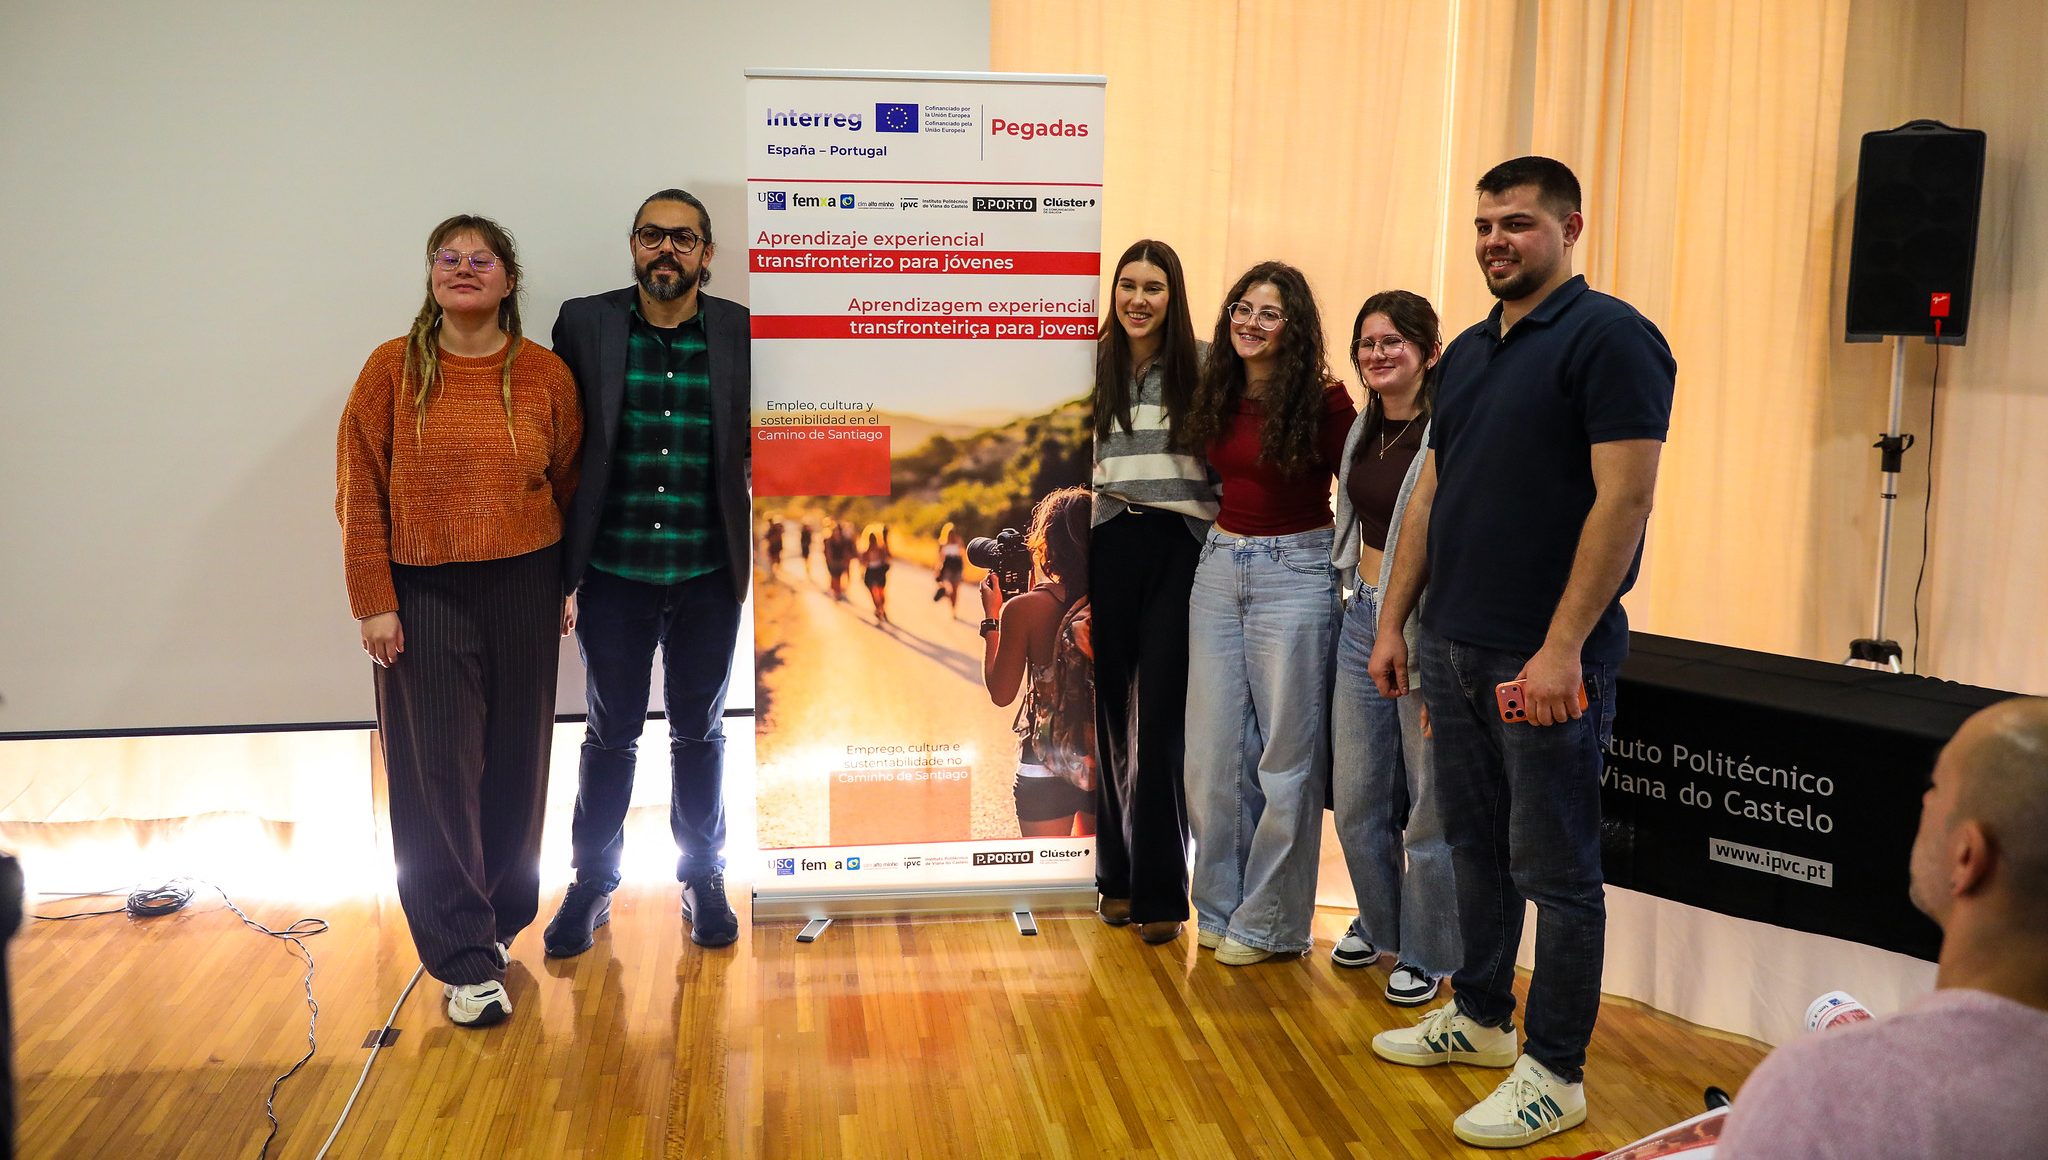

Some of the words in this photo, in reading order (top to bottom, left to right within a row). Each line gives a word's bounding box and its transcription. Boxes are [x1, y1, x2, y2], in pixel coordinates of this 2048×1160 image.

[767, 108, 862, 131] Interreg
[991, 118, 1089, 140] Pegadas
[767, 144, 816, 157] España
[830, 145, 888, 158] Portugal
[758, 192, 784, 203] USC
[792, 193, 836, 207] femxa
[900, 197, 918, 210] ipvc
[976, 199, 1033, 210] P.PORTO
[757, 230, 868, 248] Aprendizaje
[873, 232, 984, 248] experiencial
[757, 253, 894, 269] transfronterizo
[900, 258, 939, 271] para
[942, 254, 1014, 272] jóvenes
[848, 298, 983, 315] Aprendizagem
[988, 299, 1095, 315] experiencial
[850, 320, 990, 338] transfronteiriça
[996, 322, 1034, 337] para
[1038, 321, 1095, 337] jovens
[767, 400, 817, 412] Empleo,
[820, 400, 863, 410] cultura
[866, 402, 874, 412] y
[760, 415, 846, 426] sostenibilidad
[868, 415, 879, 425] el
[758, 430, 806, 440] Camino
[809, 430, 825, 440] de
[828, 430, 883, 441] Santiago
[846, 745, 905, 755] Emprego,
[908, 743, 950, 752] cultura
[844, 757, 944, 769] sustentabilidade
[1601, 734, 1662, 764] tuto
[1673, 744, 1834, 797] Politécnico
[839, 772, 894, 783] Caminho
[897, 771, 912, 780] de
[915, 770, 968, 781] Santiago
[1600, 766, 1666, 800] Viana
[1679, 782, 1713, 810] do
[1724, 791, 1833, 834] Castelo
[768, 859, 793, 869] USC
[904, 857, 921, 868] ipvc
[976, 852, 1031, 864] P.PORTO
[1716, 843, 1826, 880] www.ipvc.pt
[801, 859, 842, 871] fema
